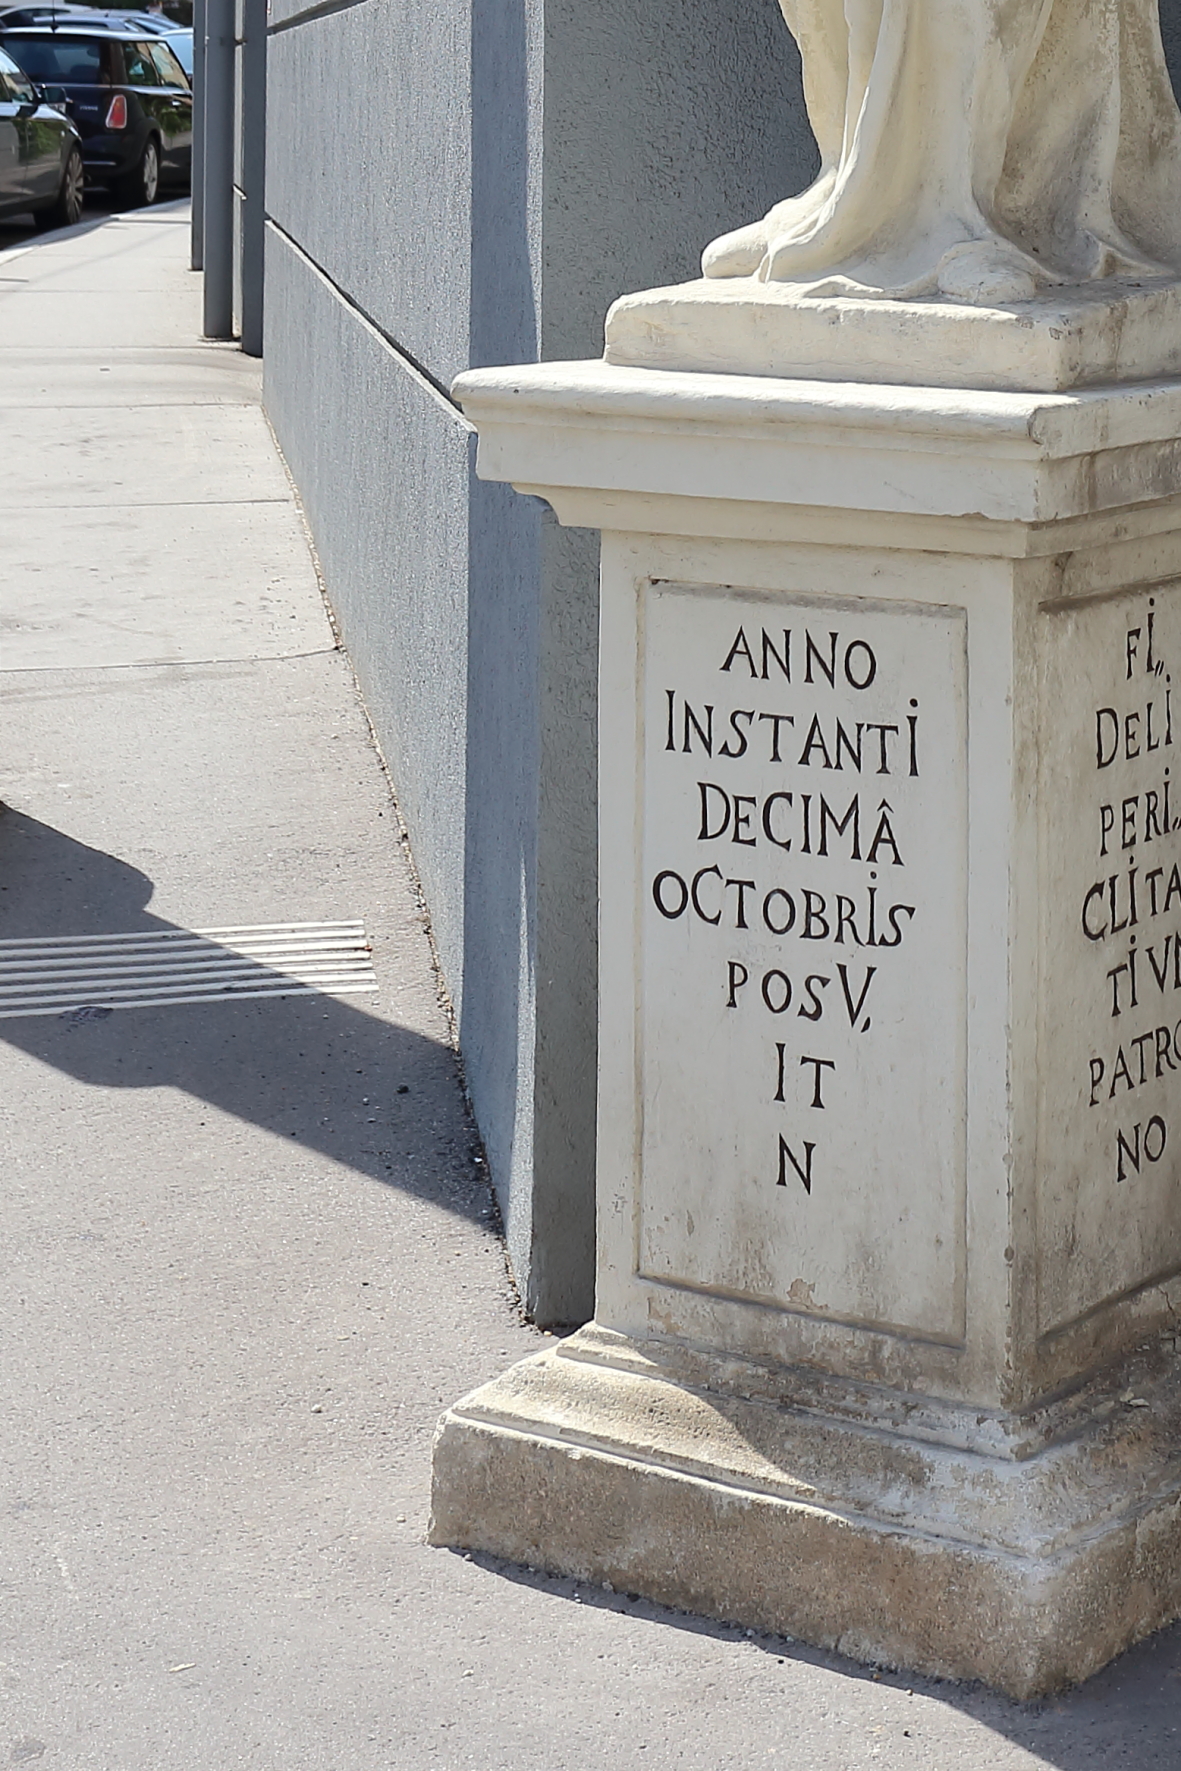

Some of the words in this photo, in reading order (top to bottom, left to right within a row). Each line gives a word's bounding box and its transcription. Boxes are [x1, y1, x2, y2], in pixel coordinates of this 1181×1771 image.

[719, 625, 877, 690] ANNO
[773, 1041, 836, 1110] IT
[775, 1131, 817, 1196] N
[1116, 1114, 1167, 1183] NO
